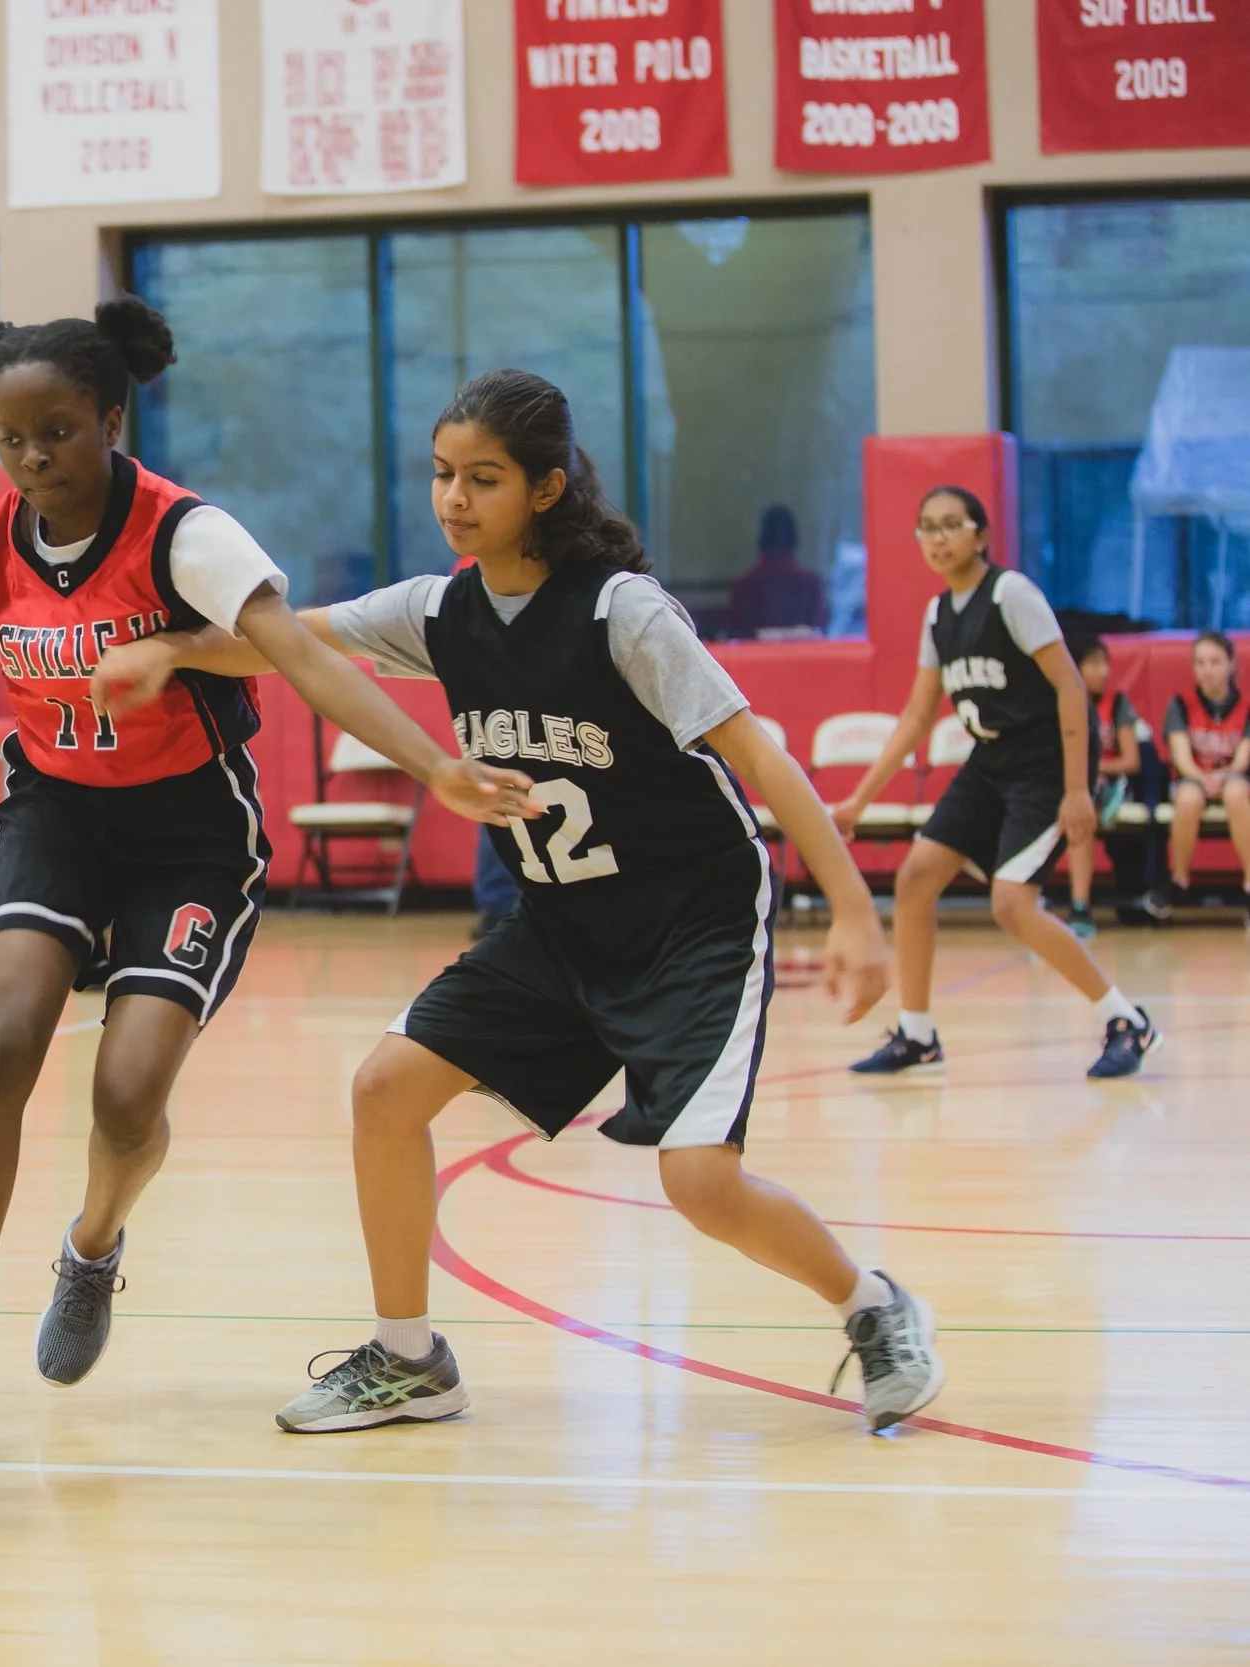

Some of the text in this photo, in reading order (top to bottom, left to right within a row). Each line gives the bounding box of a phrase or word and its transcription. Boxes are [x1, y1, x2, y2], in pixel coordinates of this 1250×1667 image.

[528, 37, 711, 87] WATER POLO
[801, 33, 958, 80] BASKETBALL
[1115, 58, 1187, 100] 2009
[803, 98, 959, 146] 2008-2009
[57, 570, 69, 588] C
[44, 694, 117, 750] 11
[452, 709, 614, 769] EAGLES
[506, 778, 620, 884] 12
[163, 902, 217, 970] C
